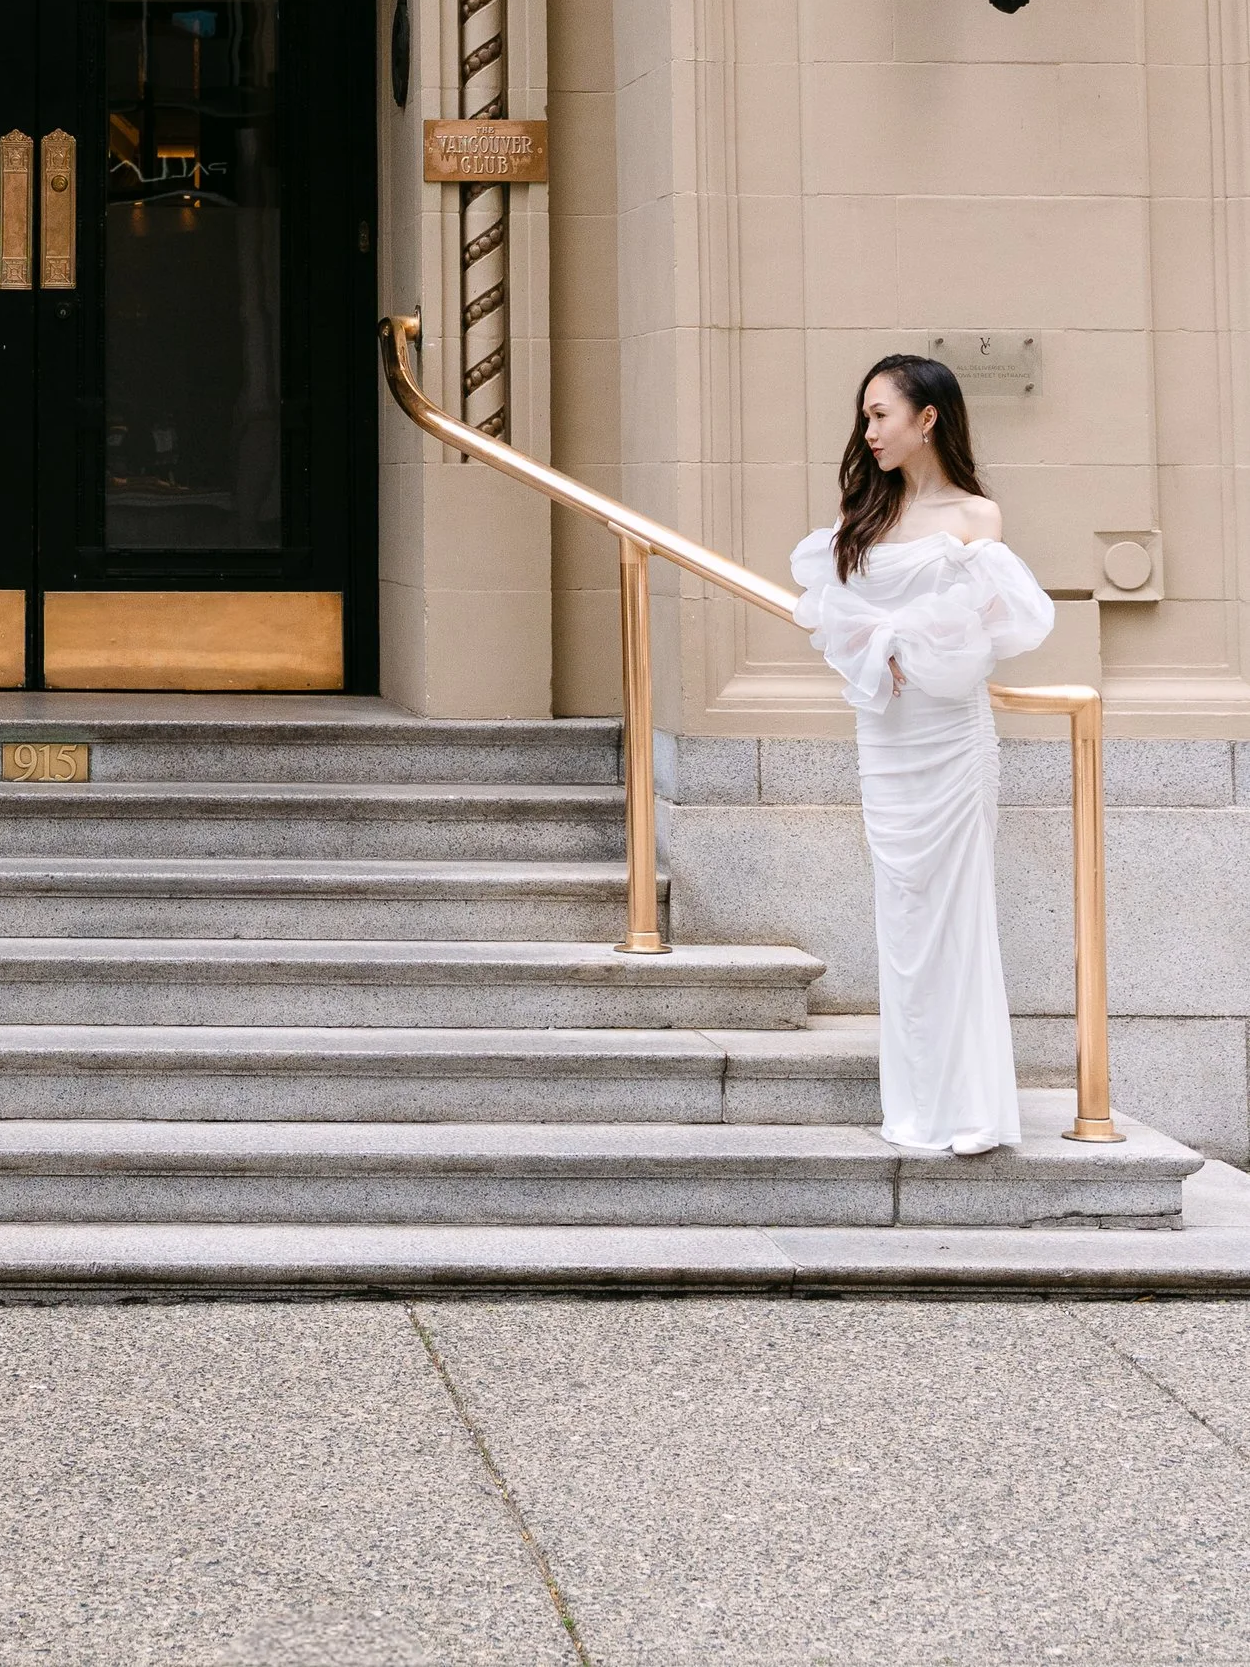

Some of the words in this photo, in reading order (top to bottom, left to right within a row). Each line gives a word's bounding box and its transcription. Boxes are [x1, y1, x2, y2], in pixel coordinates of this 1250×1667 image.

[476, 126, 495, 134] THE
[435, 135, 534, 154] VANCOUVER
[460, 156, 509, 174] CLUB
[12, 744, 78, 782] 915
